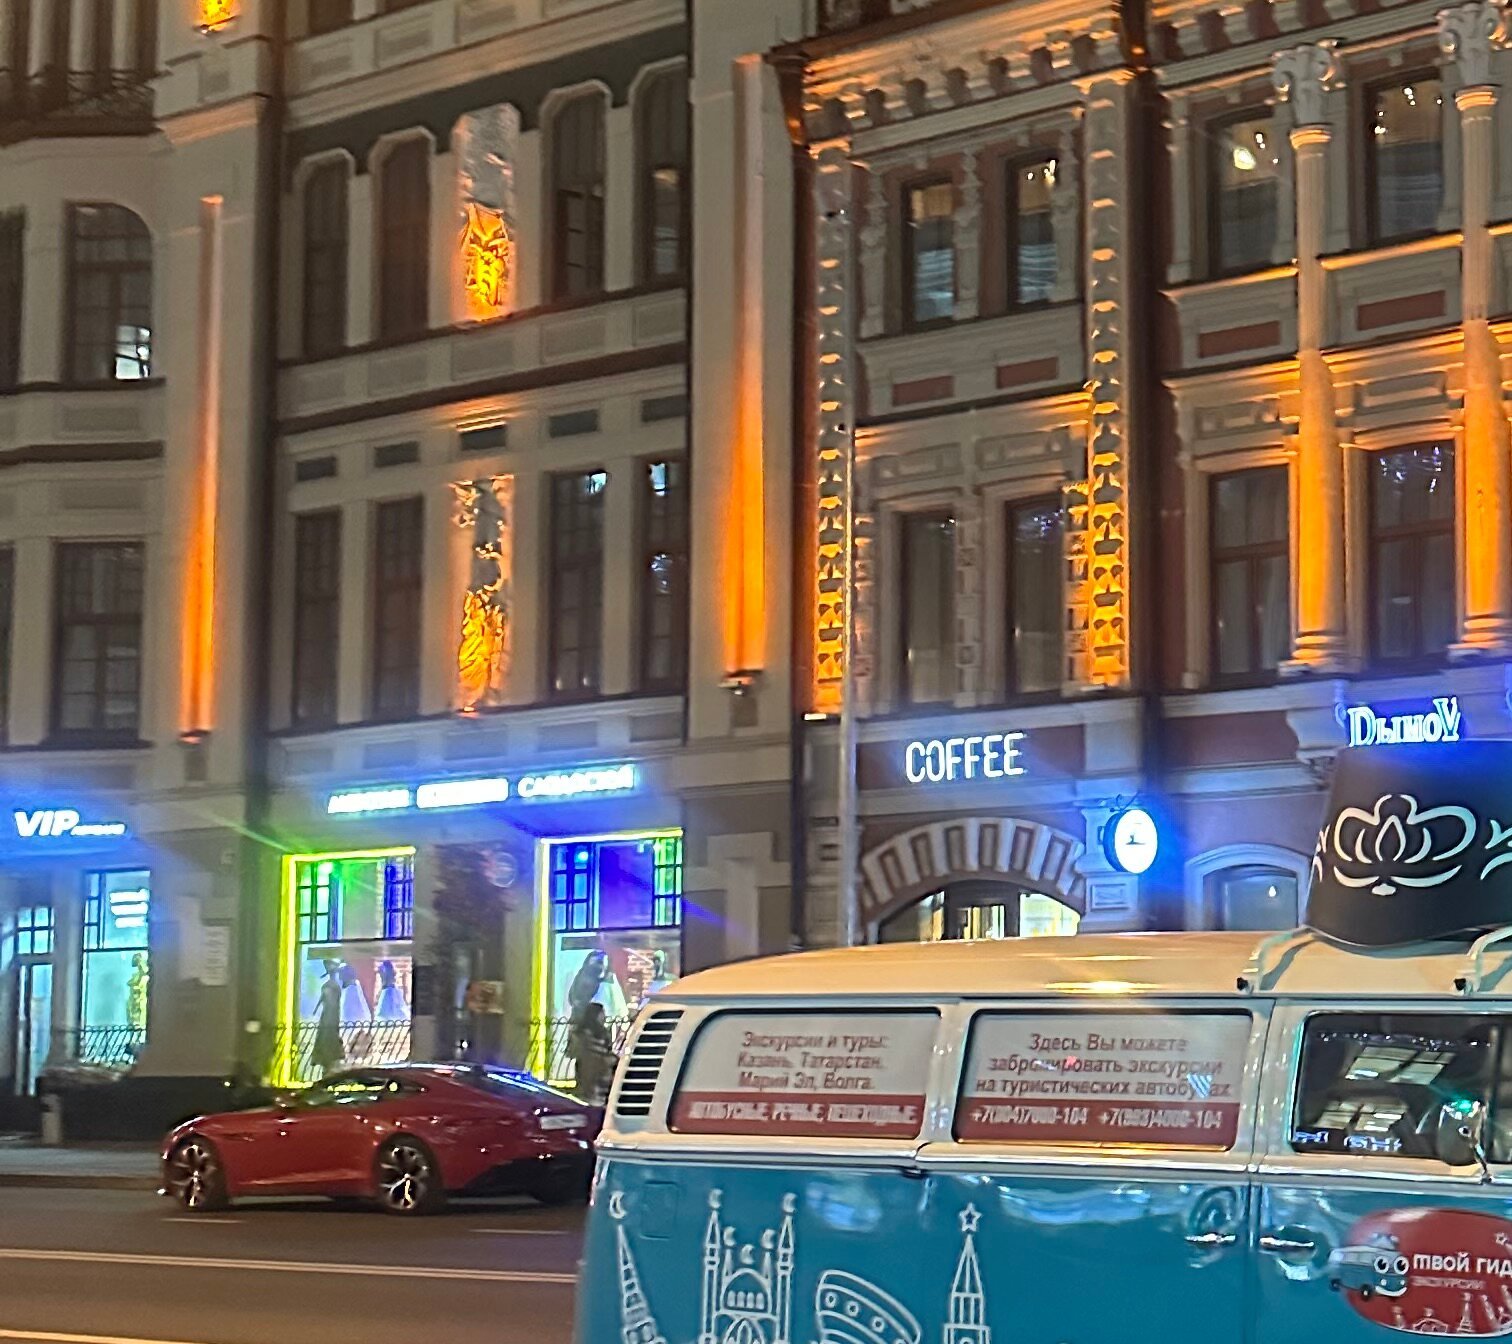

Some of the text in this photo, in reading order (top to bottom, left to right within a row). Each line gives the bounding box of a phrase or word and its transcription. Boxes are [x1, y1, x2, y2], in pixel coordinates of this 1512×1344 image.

[905, 732, 1026, 783] COFFEE
[14, 809, 80, 837] VIP
[827, 1035, 837, 1048] и
[1028, 1033, 1081, 1052] Здесь
[1086, 1033, 1115, 1051] Вы
[976, 1077, 1232, 1100] на туристических автобуах
